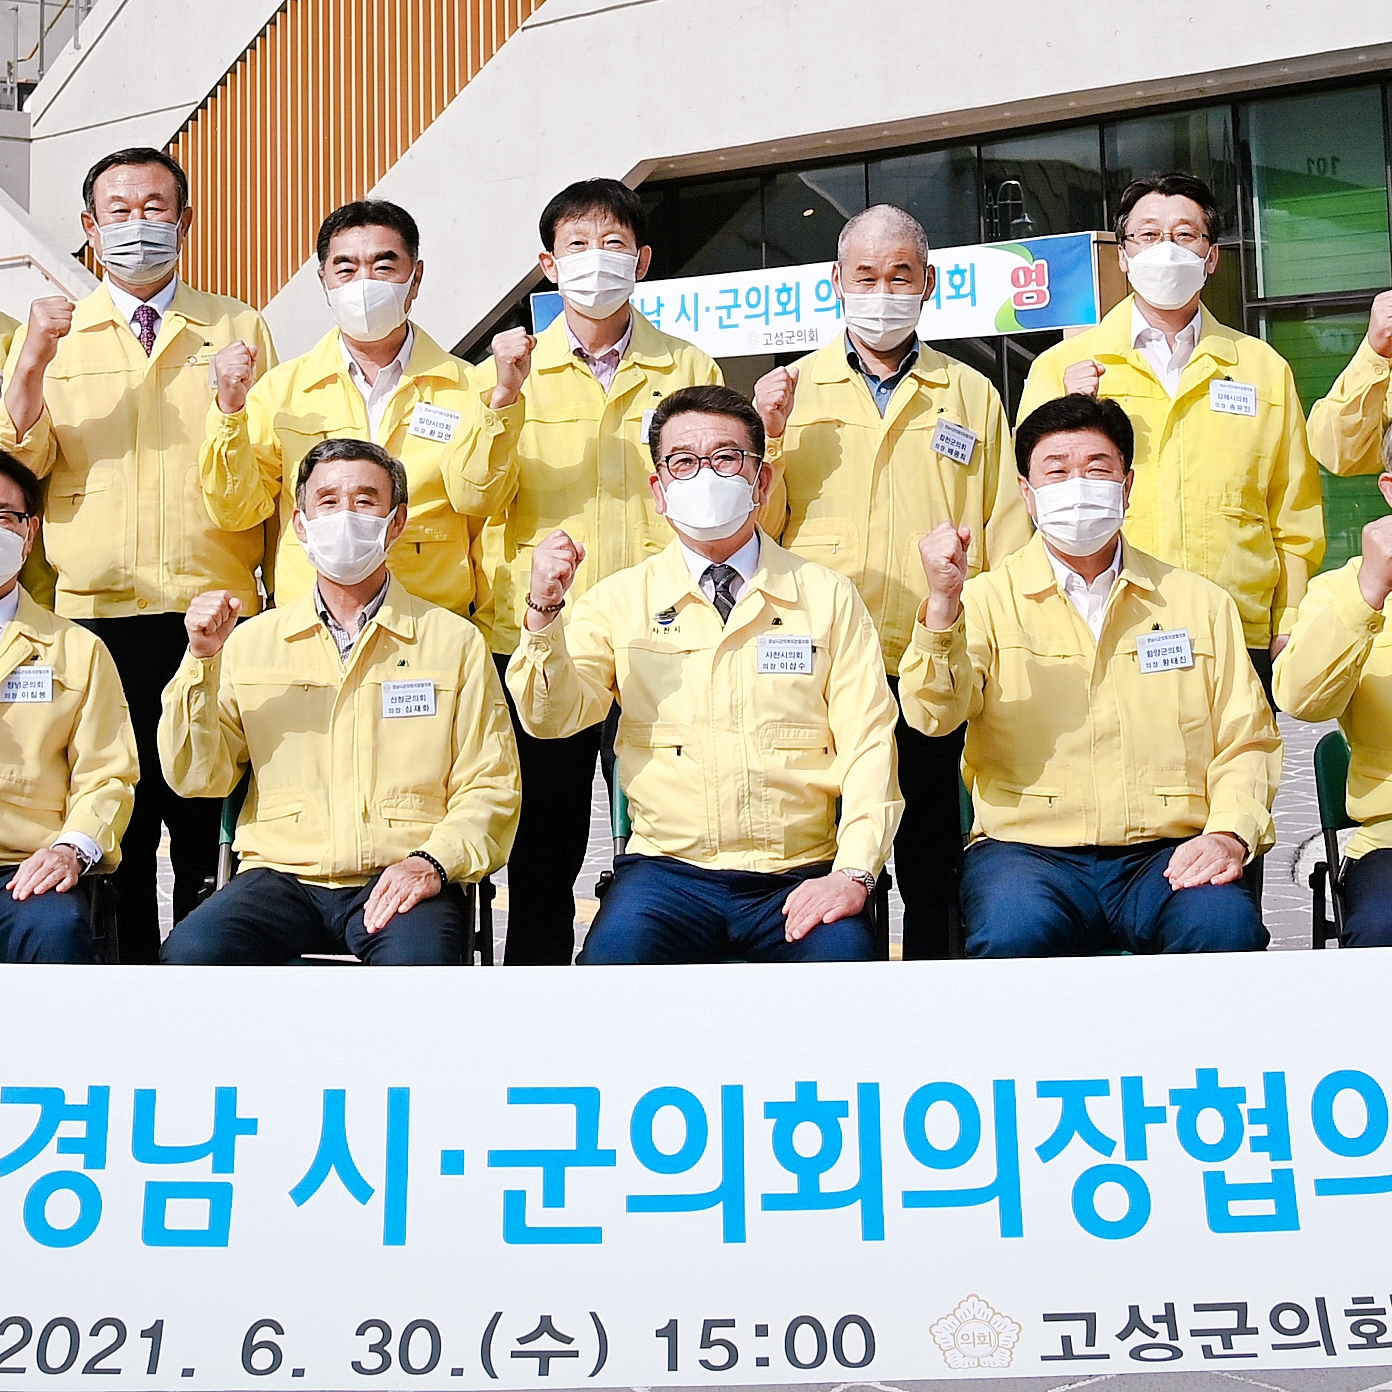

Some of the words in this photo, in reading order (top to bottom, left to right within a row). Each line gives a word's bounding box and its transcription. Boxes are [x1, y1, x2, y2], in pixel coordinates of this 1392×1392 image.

[1009, 261, 1049, 308] 영
[675, 281, 801, 332] 시·군의회
[762, 327, 819, 346] 고성군의회
[765, 651, 803, 660] 사천시의회
[762, 662, 776, 670] 의장
[241, 1318, 306, 1378] 6.
[351, 1311, 608, 1379] 30.(수)
[655, 1314, 876, 1372] 15:00
[959, 1331, 993, 1348] 의회
